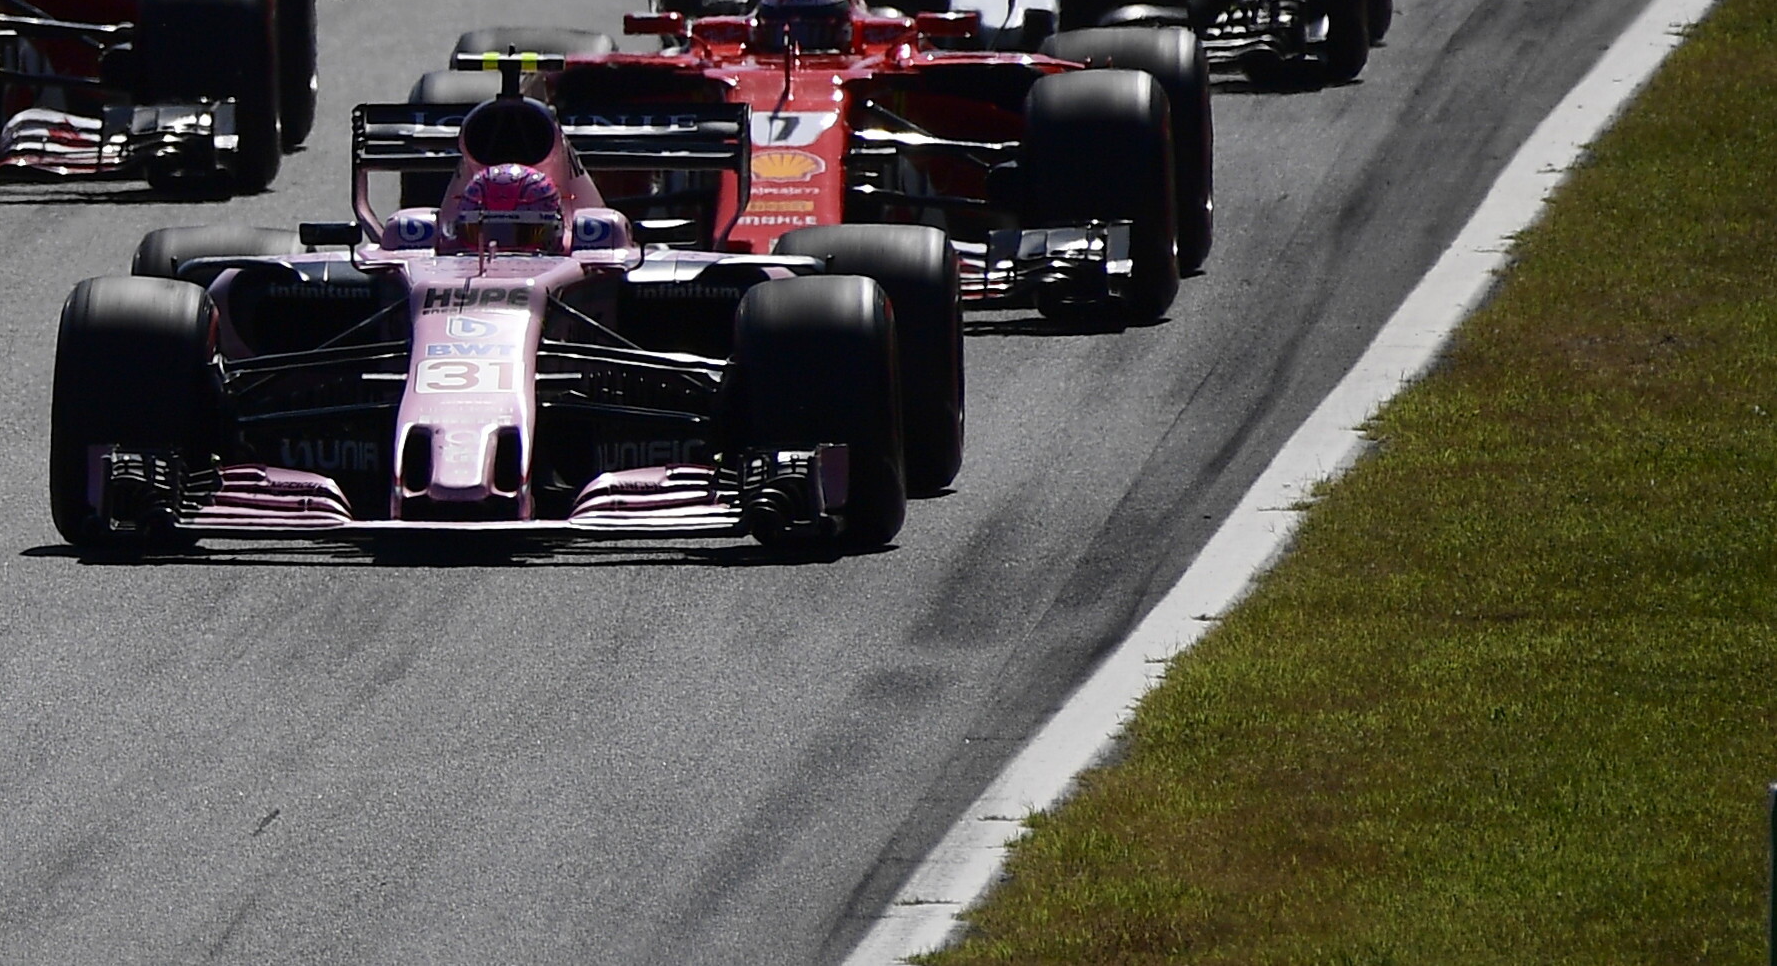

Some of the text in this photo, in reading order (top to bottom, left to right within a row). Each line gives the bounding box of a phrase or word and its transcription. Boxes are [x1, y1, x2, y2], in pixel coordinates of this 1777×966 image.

[768, 116, 800, 142] 7
[423, 288, 530, 308] HYPE
[427, 344, 516, 356] BWT
[426, 361, 513, 391] 31
